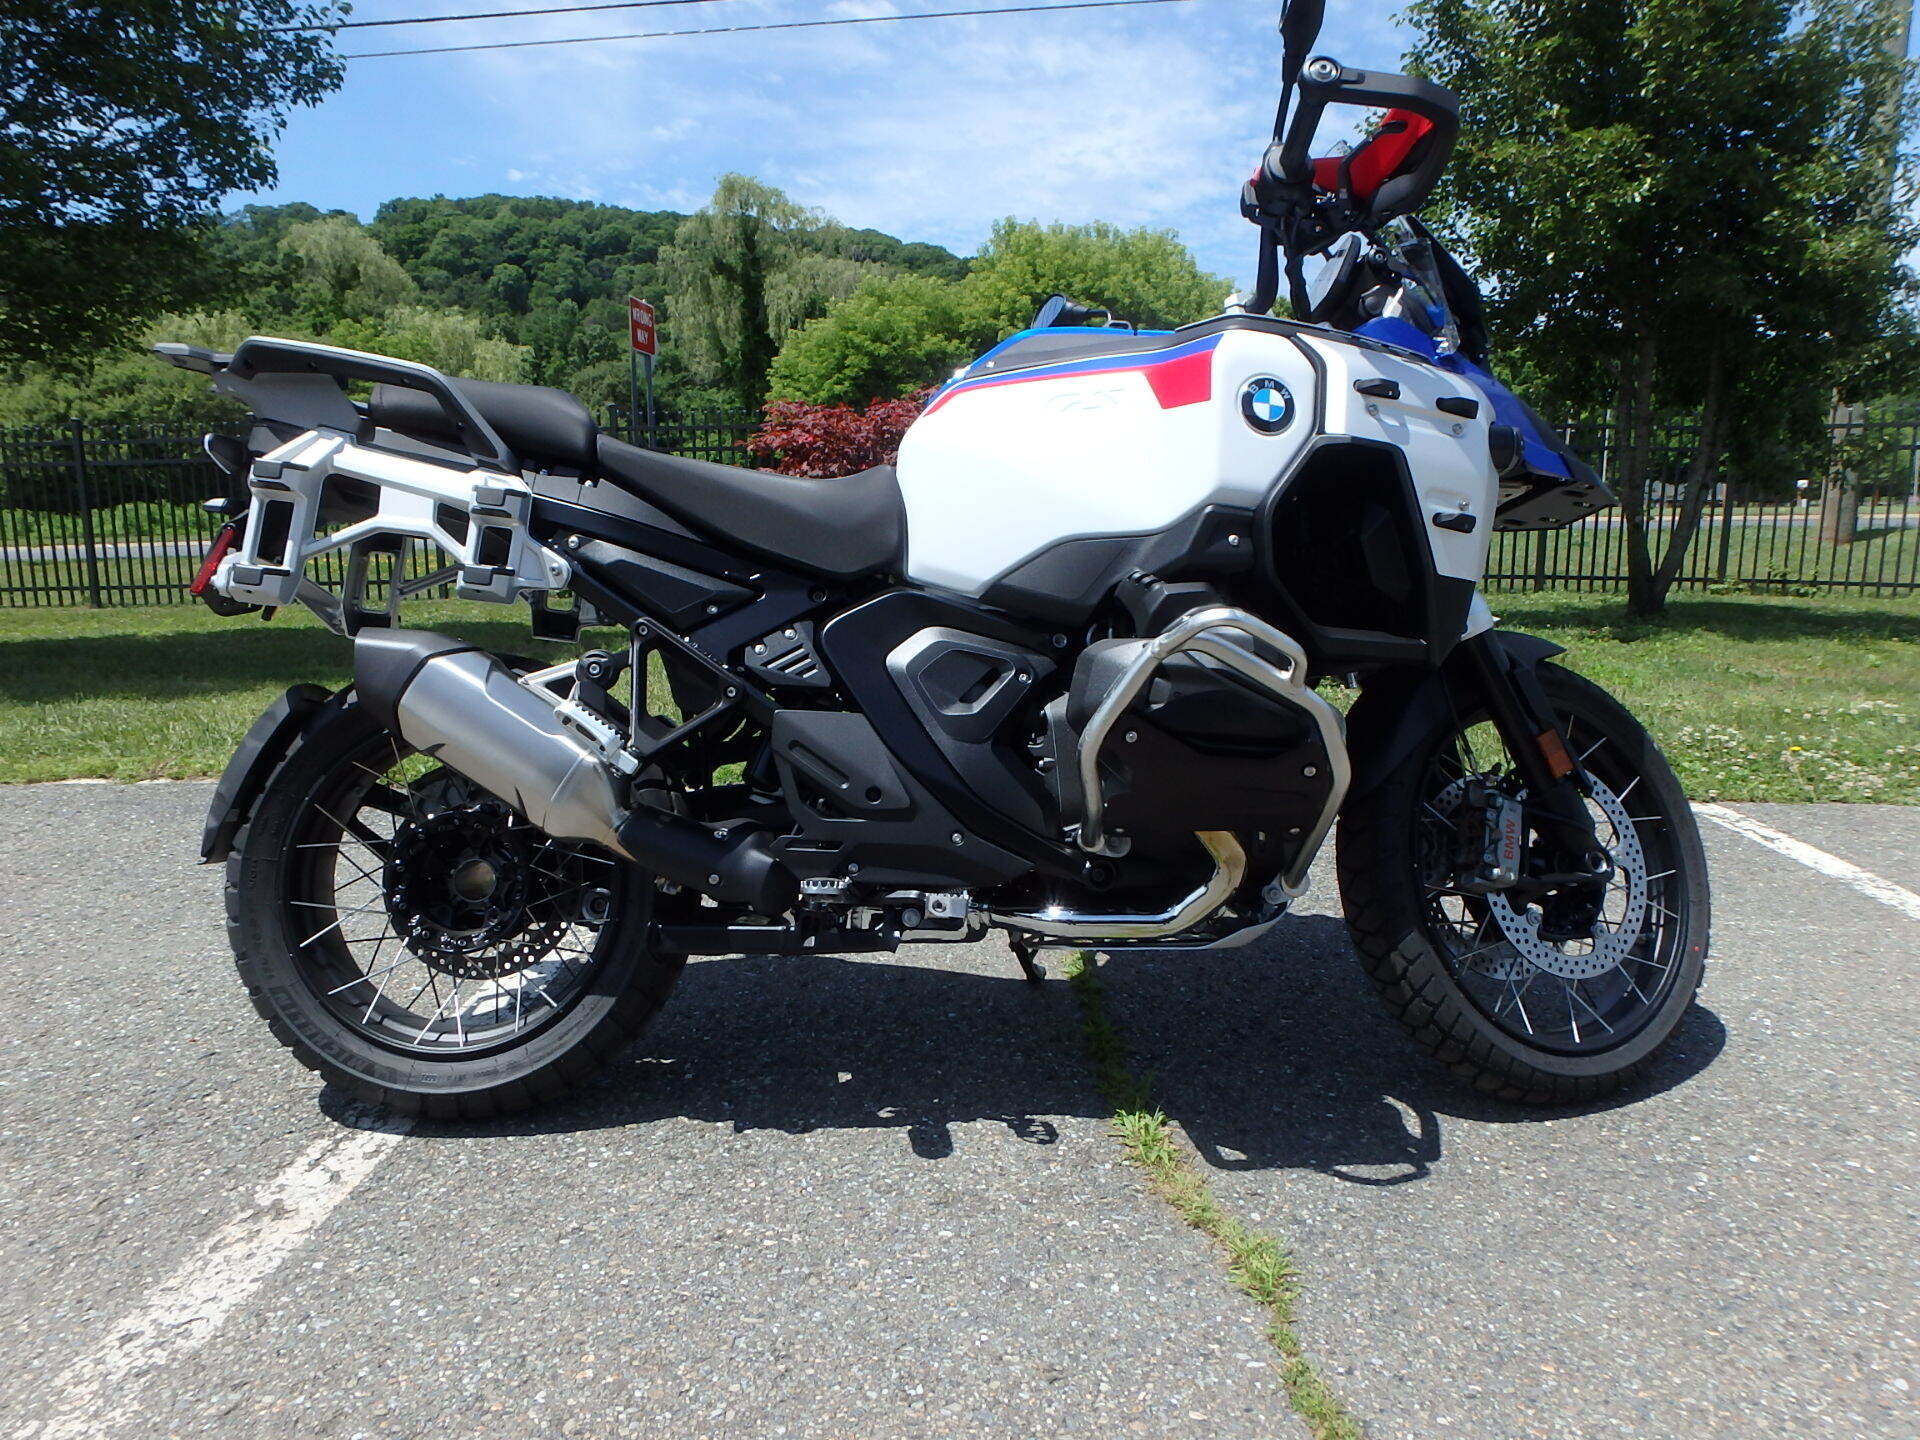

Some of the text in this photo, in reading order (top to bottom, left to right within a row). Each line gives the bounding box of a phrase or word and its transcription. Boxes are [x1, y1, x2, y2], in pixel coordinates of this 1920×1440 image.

[632, 307, 653, 328] WRONG
[636, 328, 649, 345] WAY
[1248, 379, 1291, 400] BMW
[1504, 819, 1516, 860] BMW
